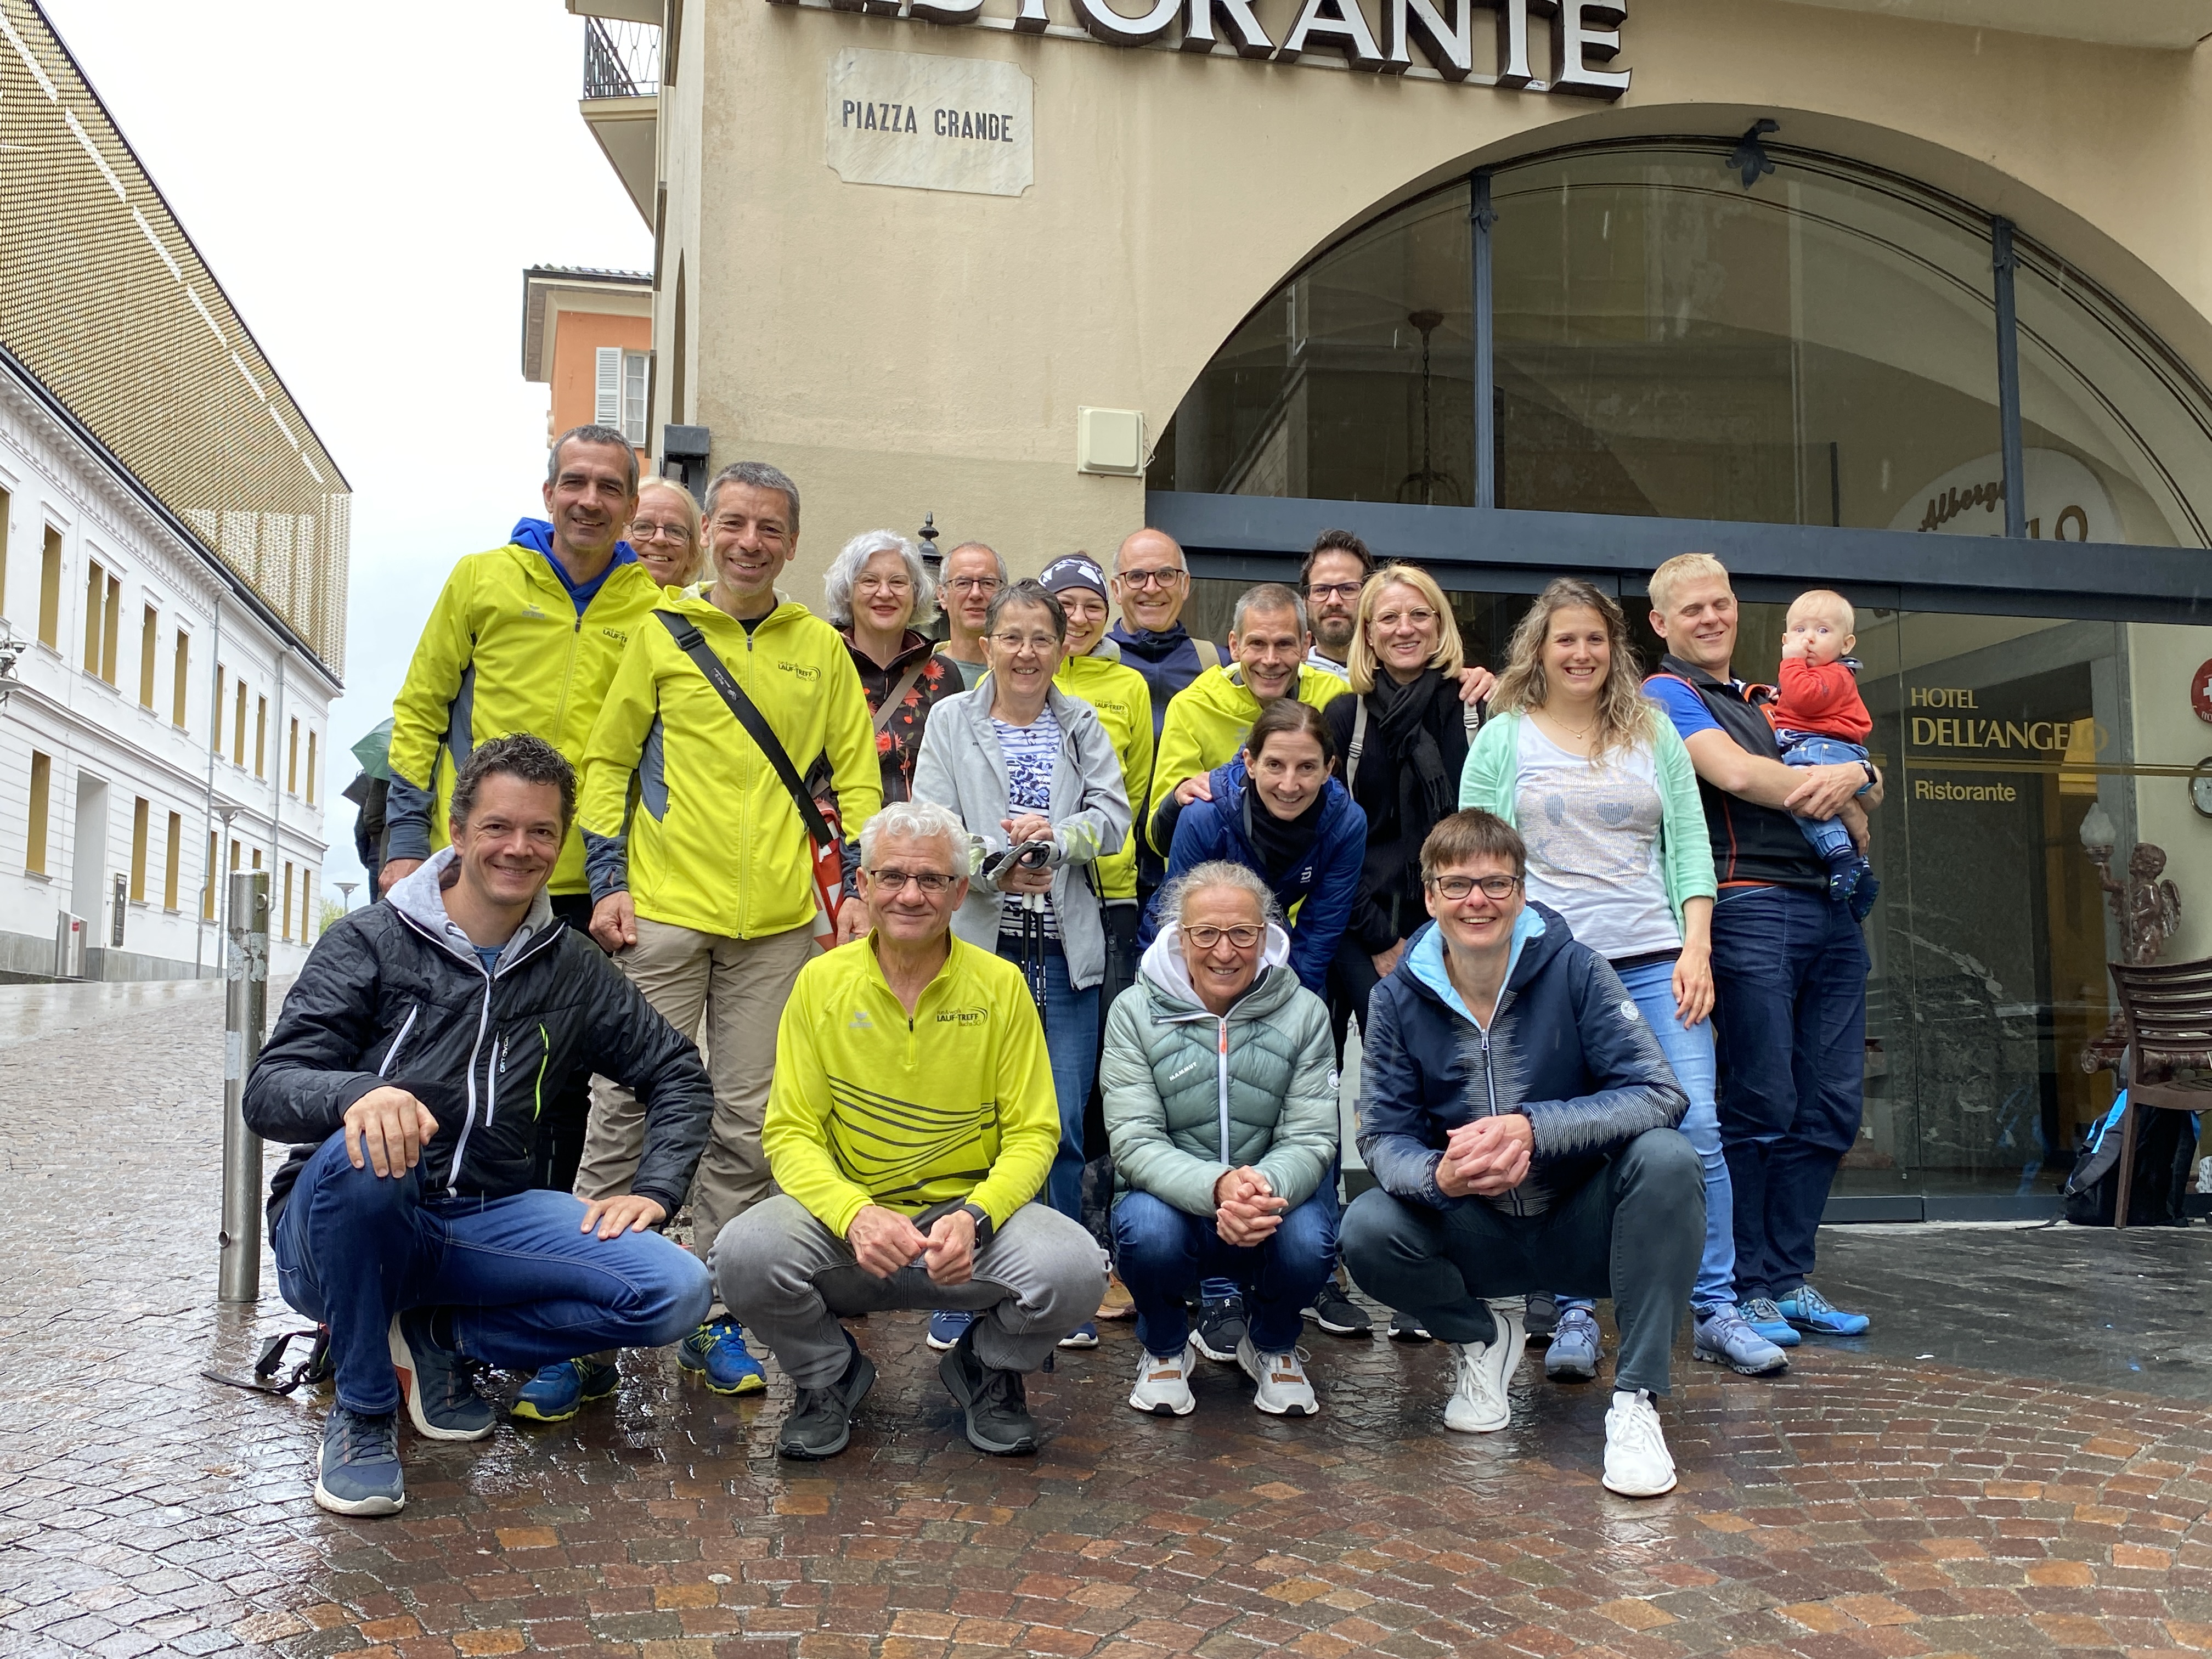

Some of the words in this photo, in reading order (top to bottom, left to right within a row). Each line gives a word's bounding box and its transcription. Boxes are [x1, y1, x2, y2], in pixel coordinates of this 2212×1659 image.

[843, 99, 917, 134] PIAZZA
[934, 109, 1013, 143] GRANDE
[1911, 687, 1979, 709] HOTEL
[1915, 780, 2017, 802] Ristorante
[937, 1013, 978, 1022] LAUF-TREFF
[1169, 1062, 1197, 1081] MAMMUT
